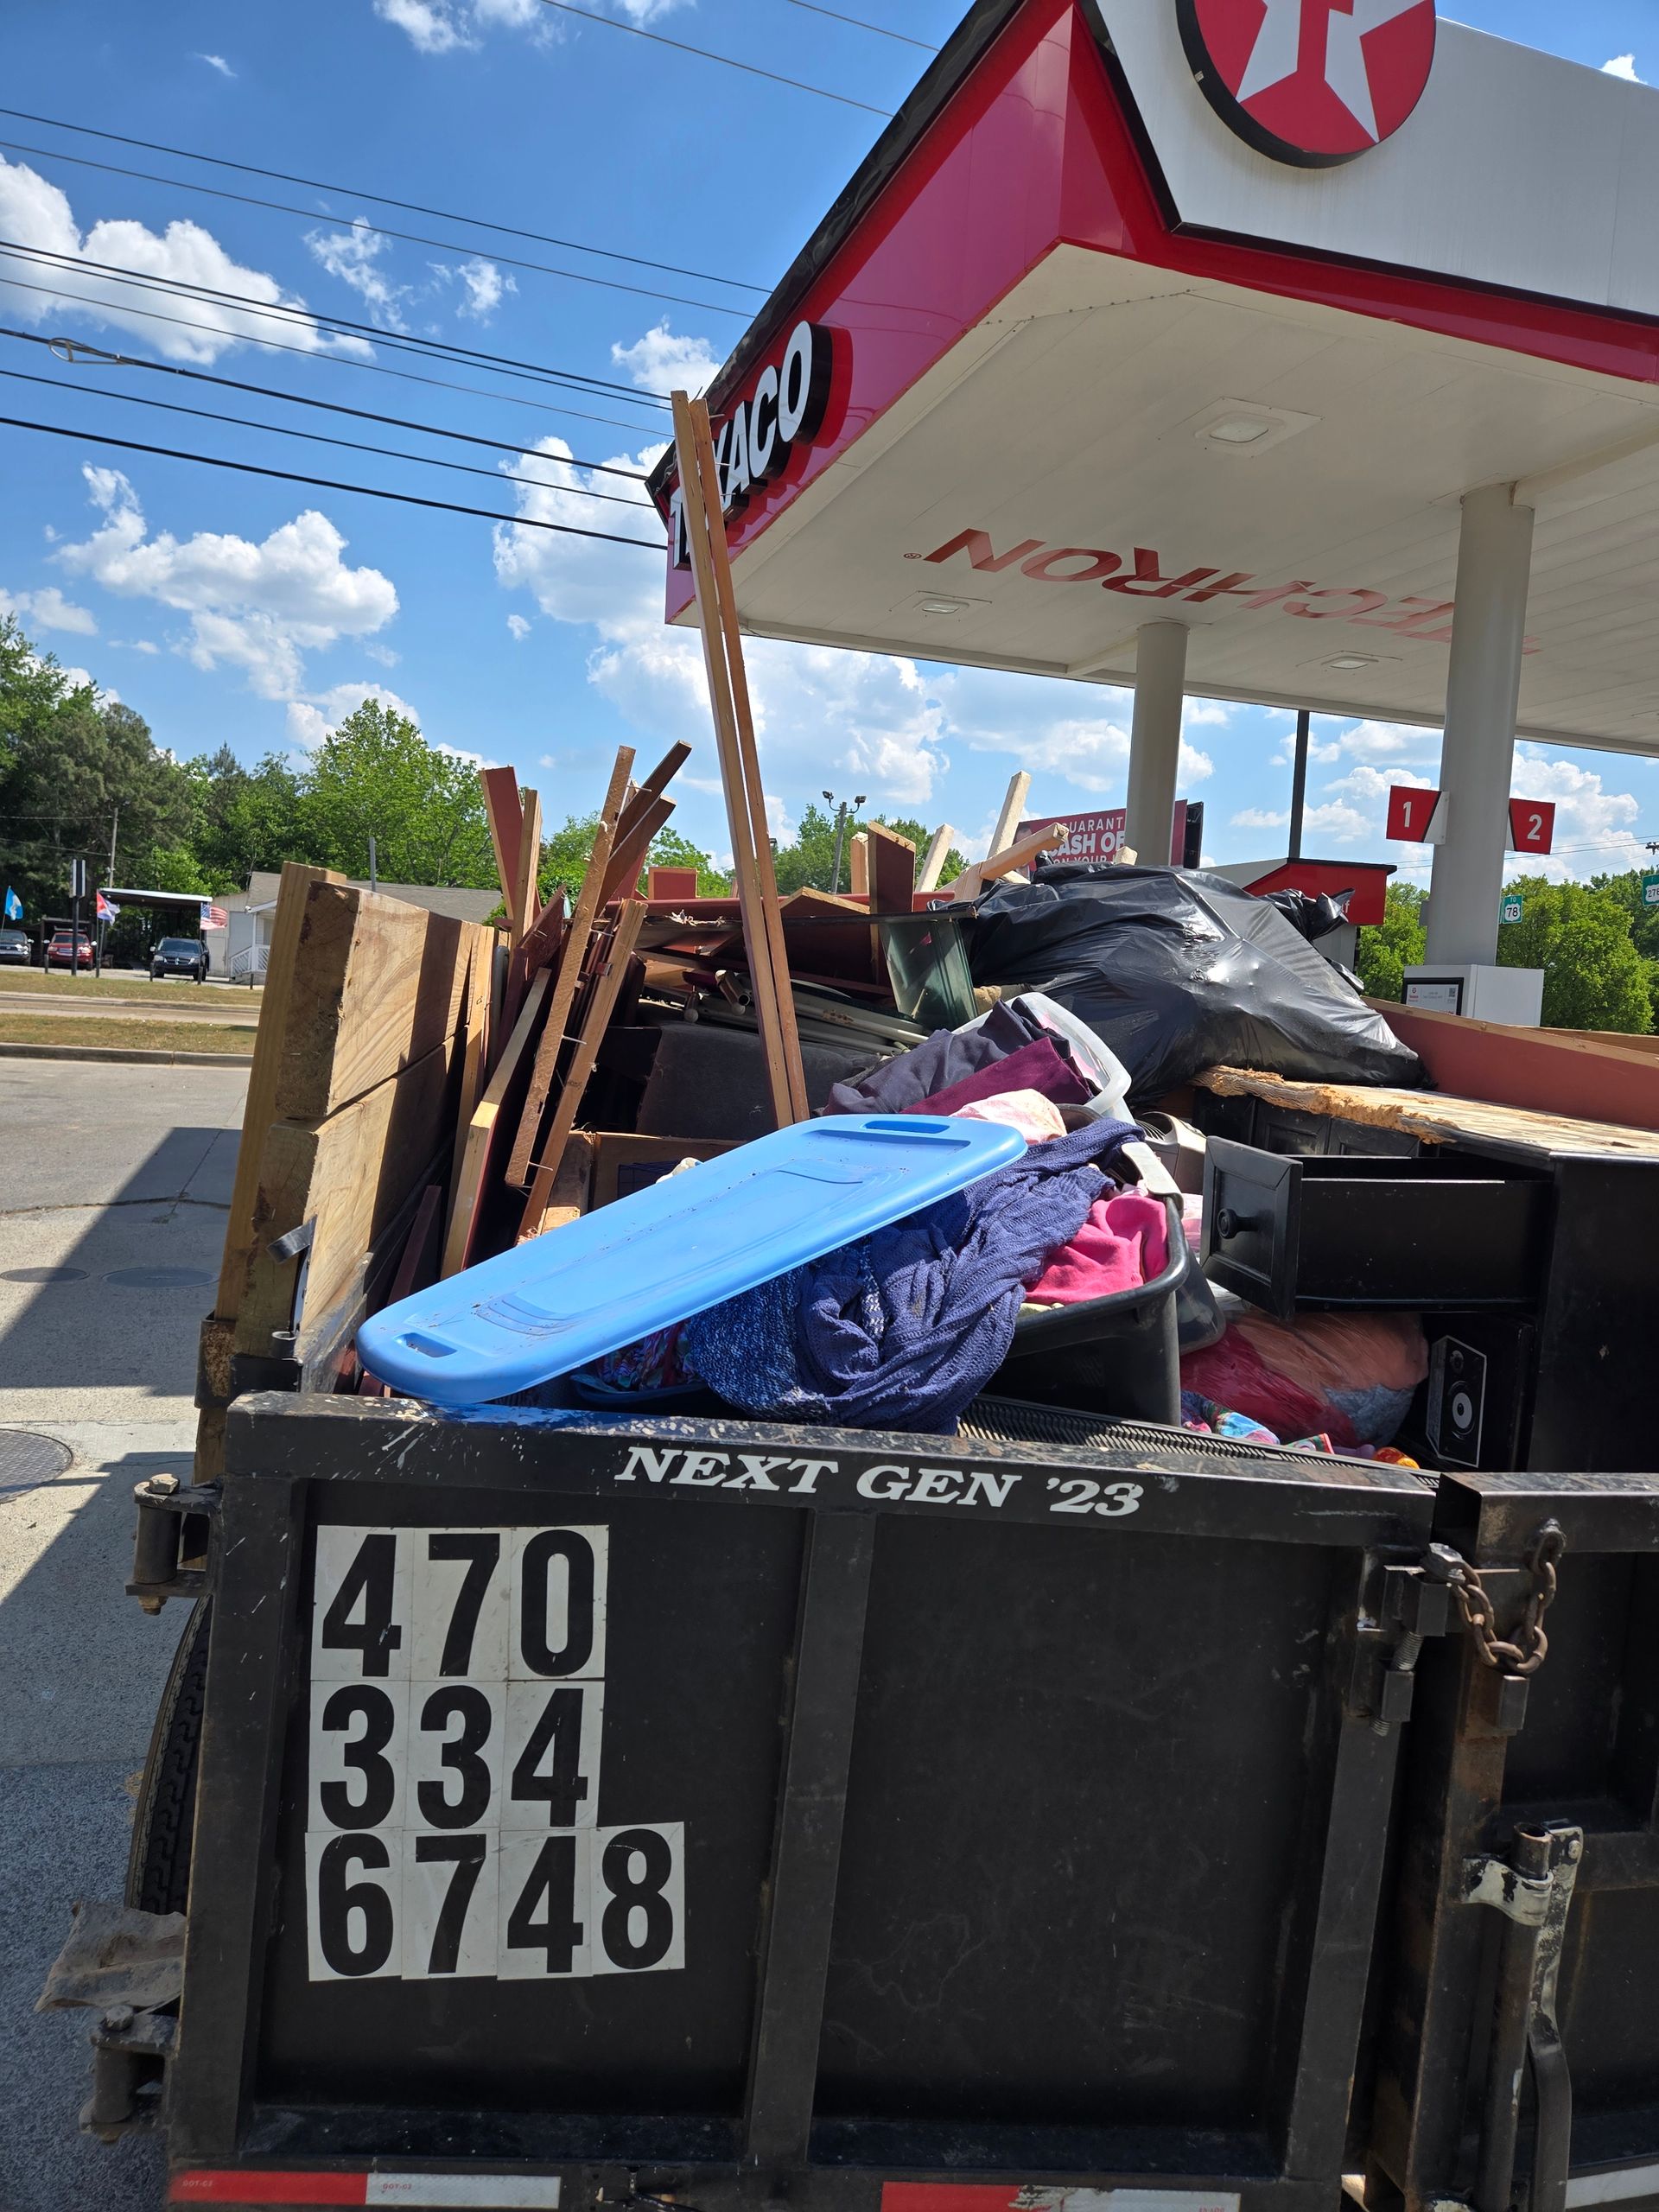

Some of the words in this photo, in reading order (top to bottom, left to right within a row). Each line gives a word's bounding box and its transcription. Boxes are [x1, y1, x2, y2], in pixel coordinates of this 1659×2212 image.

[669, 320, 813, 570] TACO
[1402, 801, 1413, 828] 1
[1527, 813, 1542, 841] 2
[1506, 906, 1519, 918] 78
[614, 1446, 838, 1493] NEXT
[856, 1465, 1022, 1508] GEN
[1046, 1478, 1145, 1516] '23
[321, 1529, 594, 1676] 470
[320, 1684, 588, 1830] 334
[318, 1827, 674, 1977] 6748
